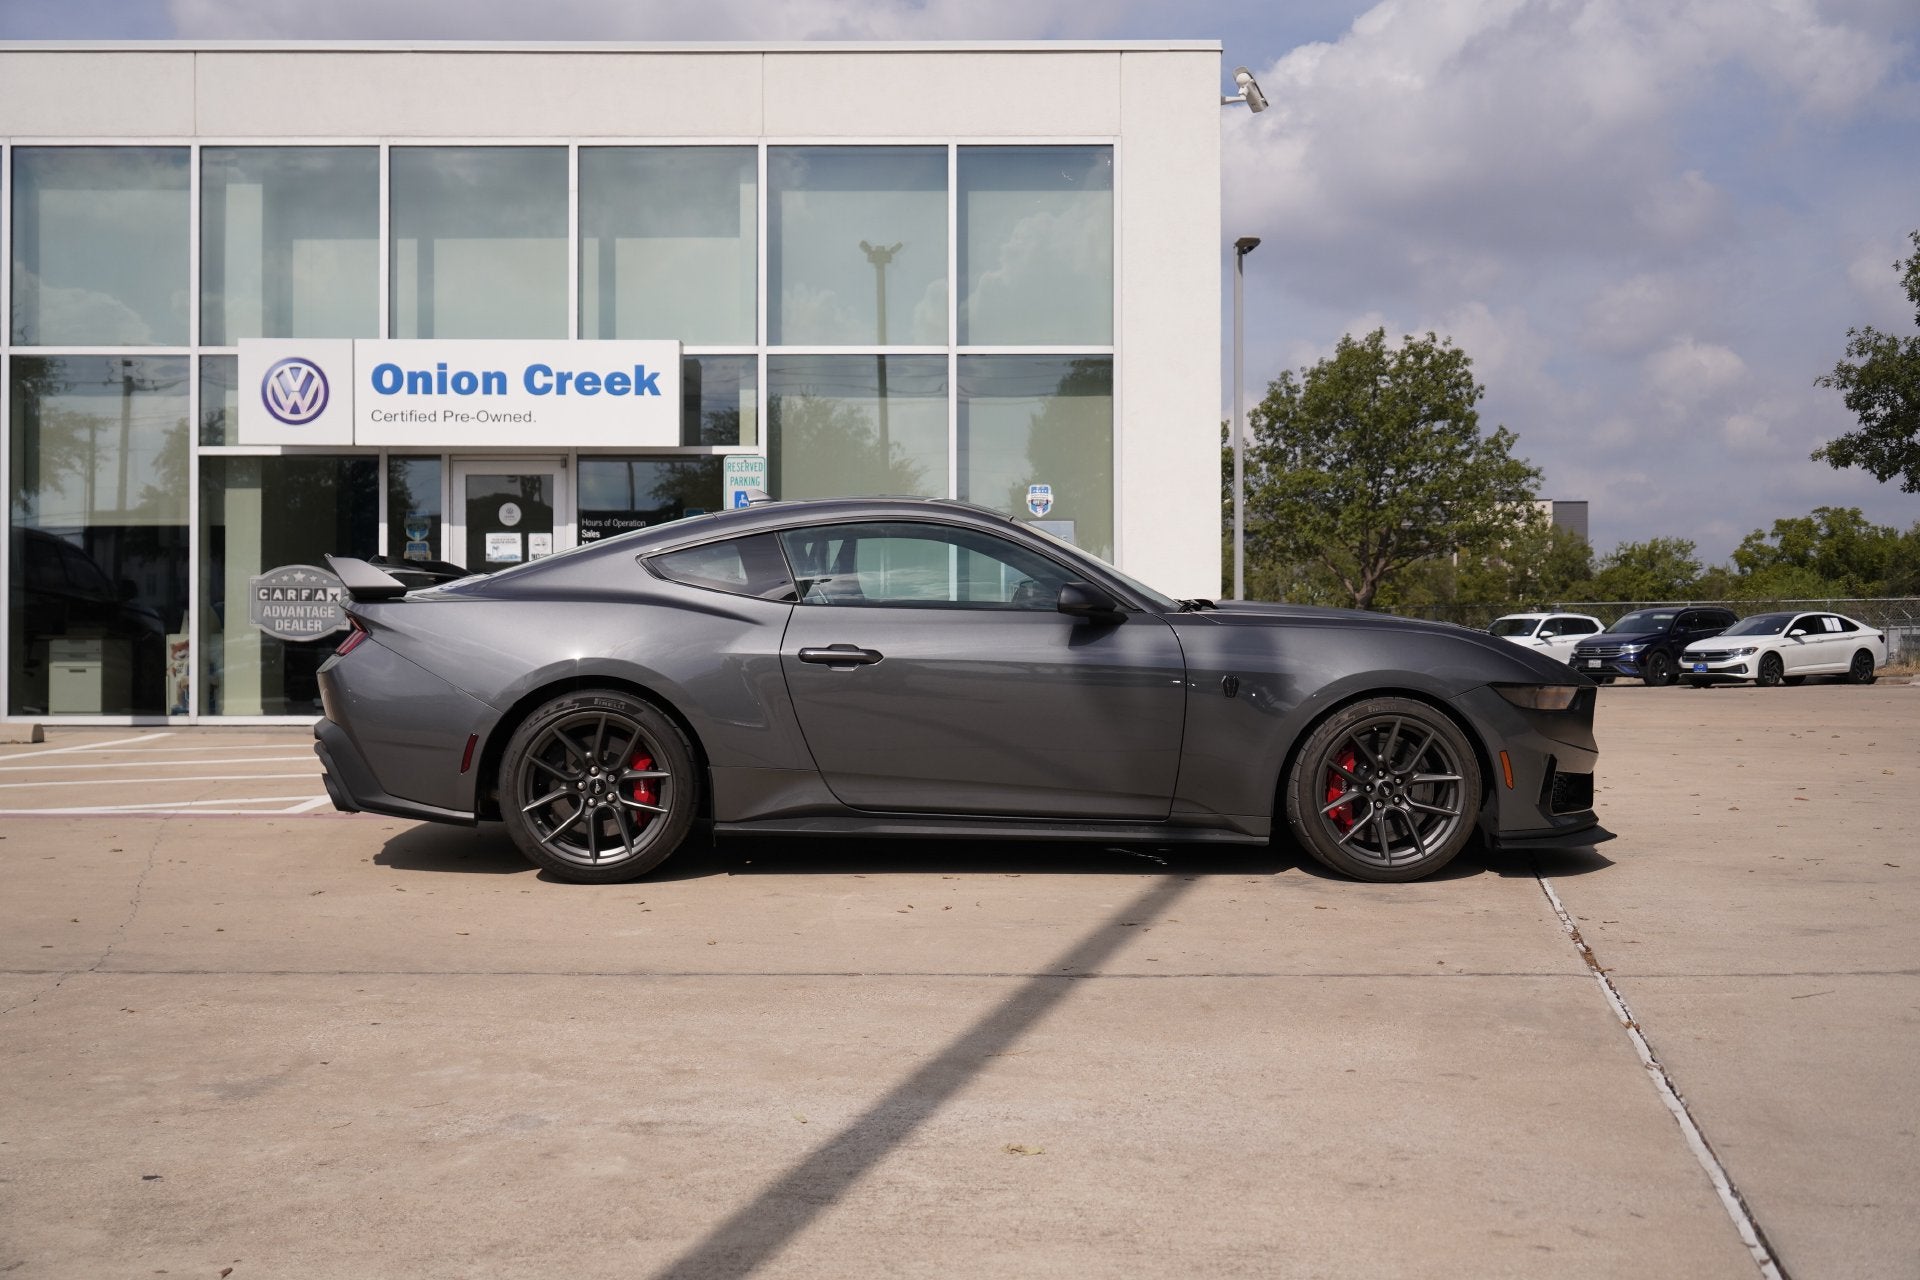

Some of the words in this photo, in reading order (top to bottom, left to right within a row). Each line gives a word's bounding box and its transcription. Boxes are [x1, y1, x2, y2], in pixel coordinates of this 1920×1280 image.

[371, 362, 508, 396] Onion
[523, 363, 662, 397] Creek
[371, 409, 437, 423] Certified
[443, 410, 537, 424] Pre-Owned.
[726, 462, 764, 472] RESERVED
[730, 476, 761, 487] PARKING
[581, 518, 602, 527] Hours
[604, 518, 611, 527] of
[612, 519, 647, 529] Operation
[581, 529, 600, 539] Sales
[258, 587, 341, 602] CARFAX
[262, 605, 336, 619] ADVANTAGE
[274, 619, 323, 632] DEALER
